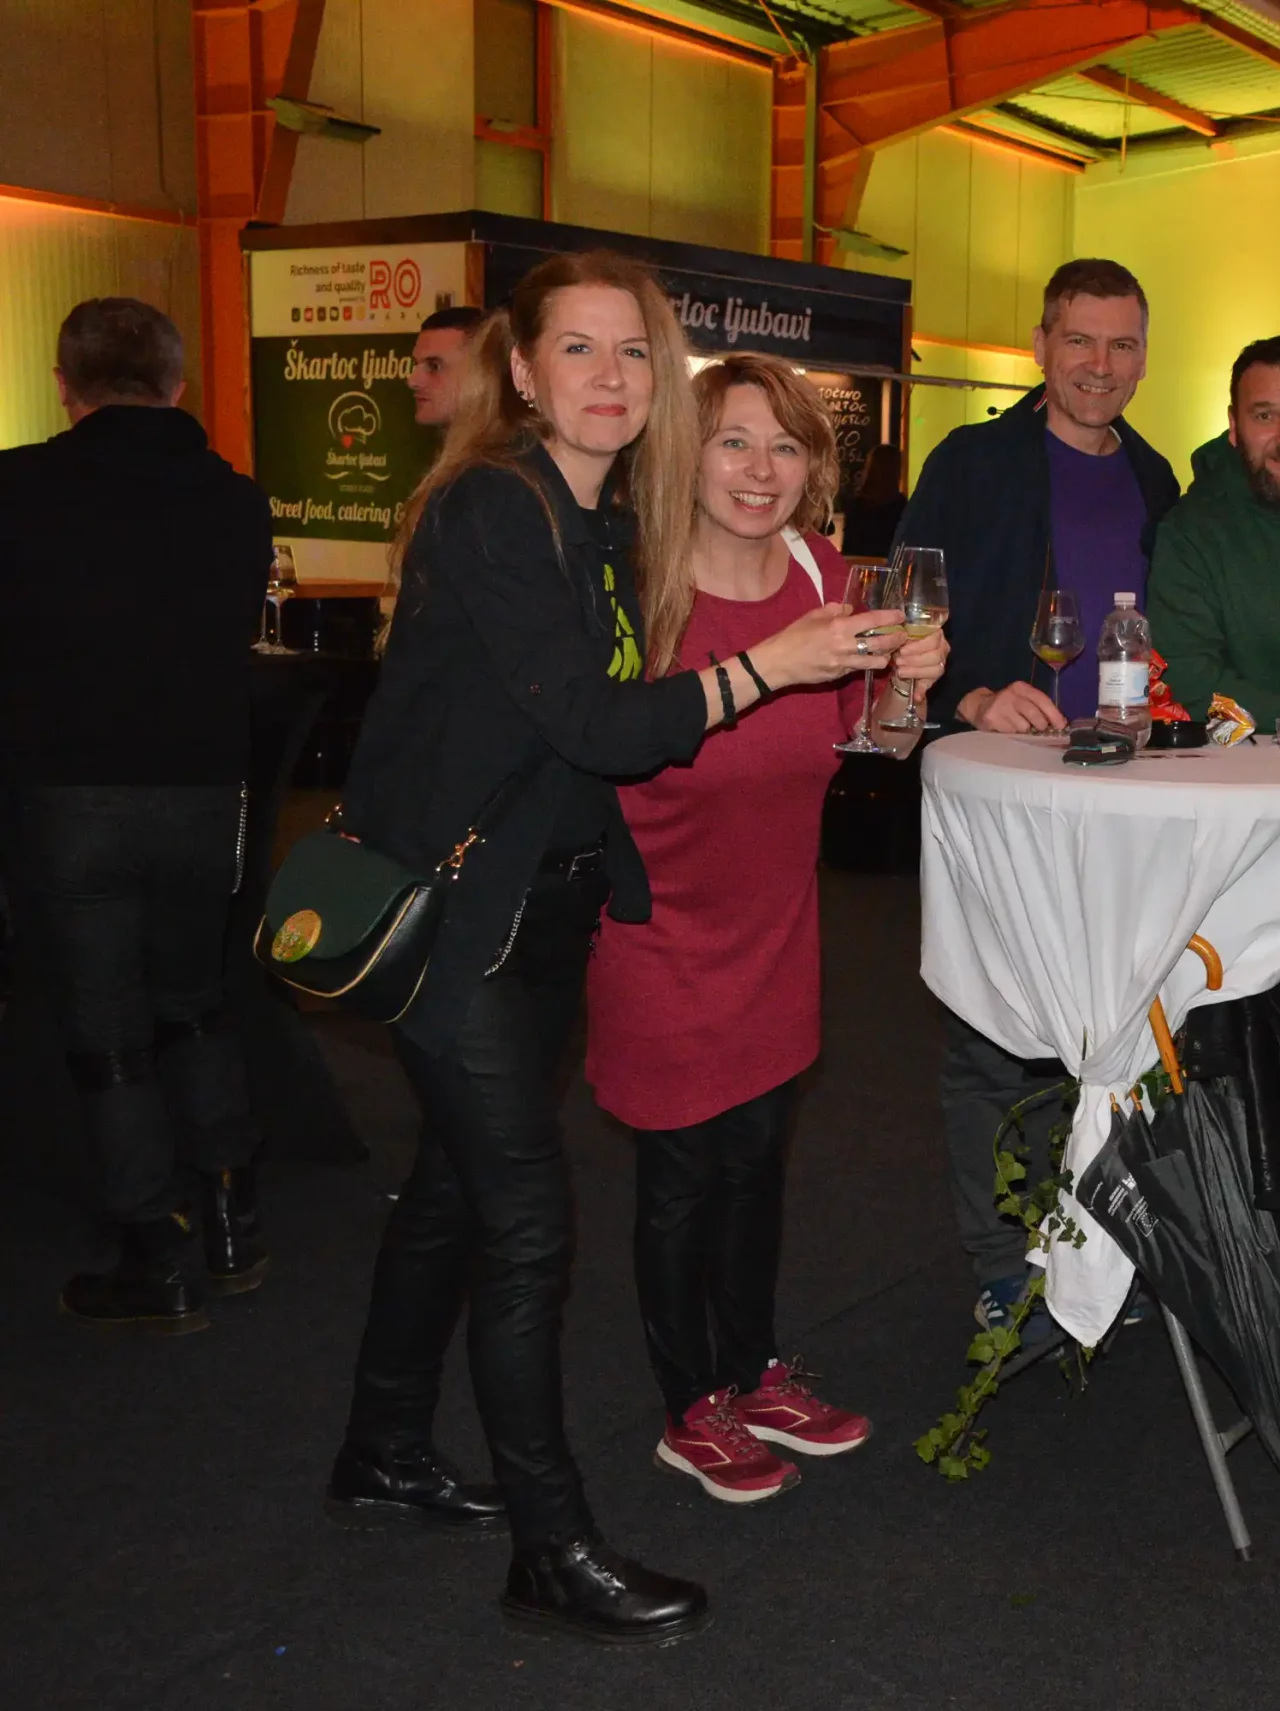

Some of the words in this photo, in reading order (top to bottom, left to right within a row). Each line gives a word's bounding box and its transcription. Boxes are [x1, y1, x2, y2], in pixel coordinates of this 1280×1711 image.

[290, 263, 329, 276] Richness
[331, 261, 341, 274] of
[342, 261, 366, 274] taste
[315, 281, 332, 293] and
[334, 279, 366, 295] quality
[672, 292, 719, 331] rtoc
[724, 297, 812, 343] ljubavi
[284, 338, 358, 380] Škartoc
[361, 349, 414, 389] ljuba
[269, 496, 302, 518] Street
[302, 498, 335, 525] food,
[338, 502, 391, 530] catering
